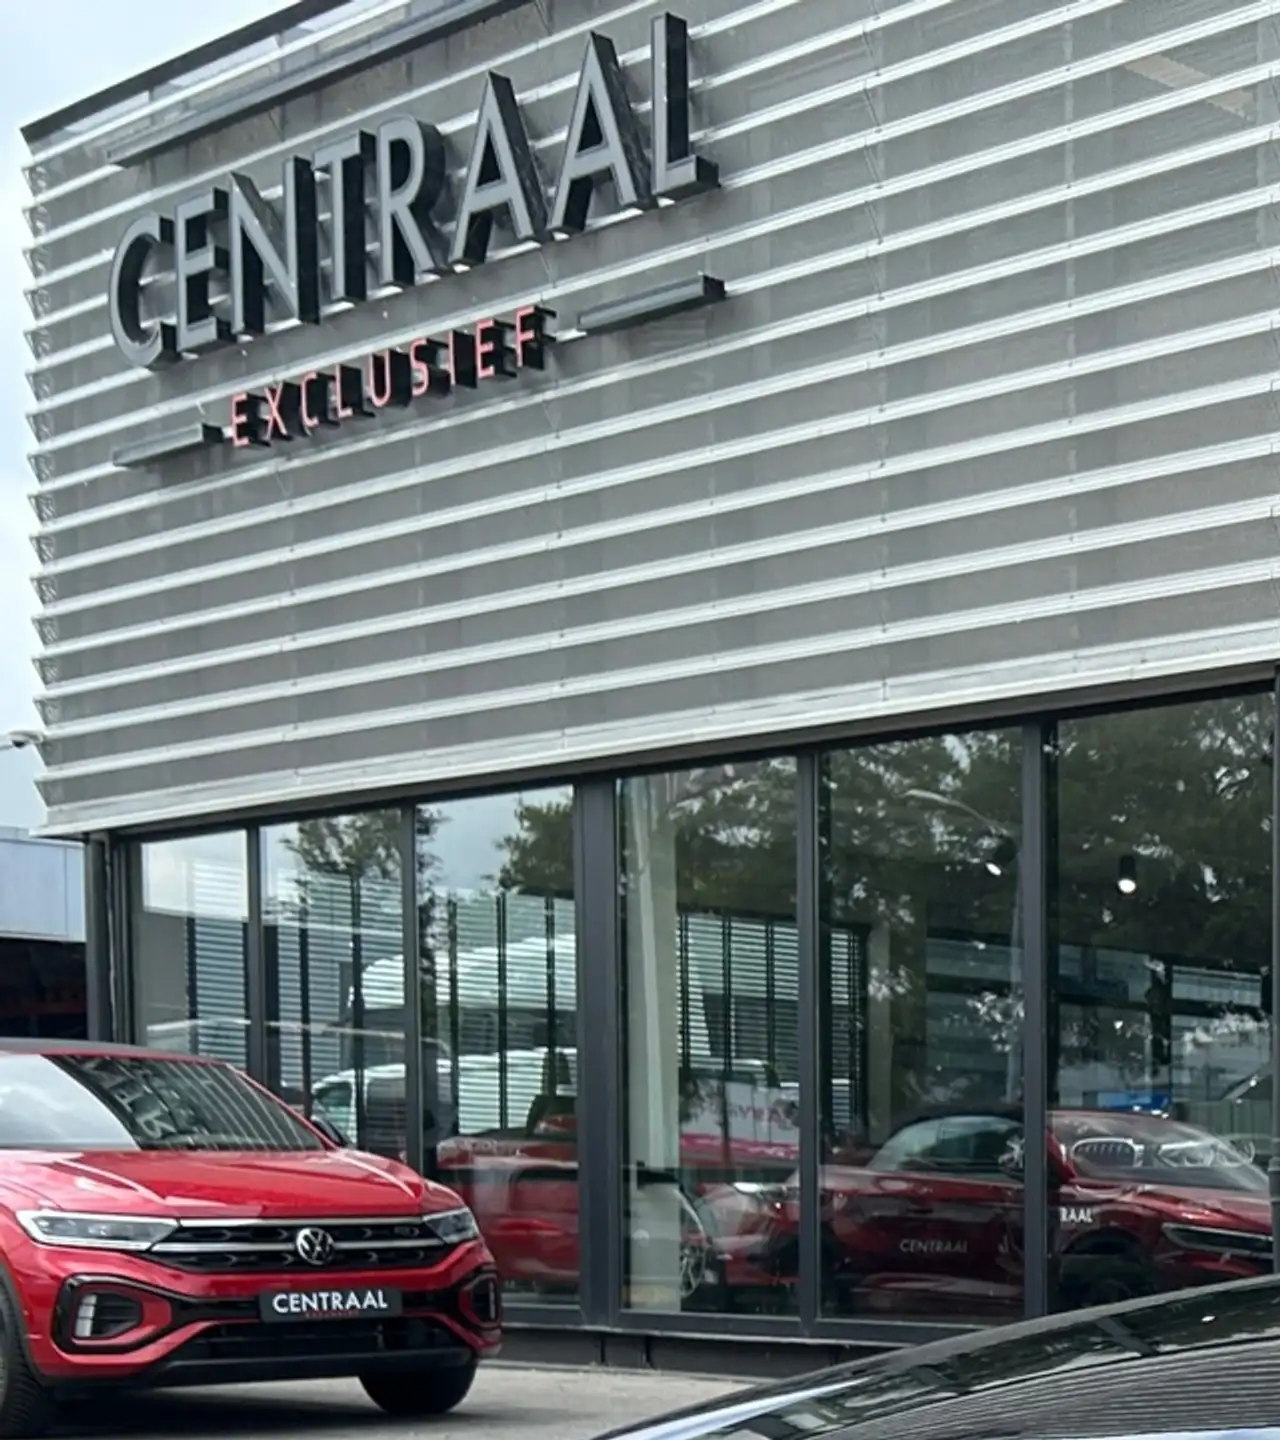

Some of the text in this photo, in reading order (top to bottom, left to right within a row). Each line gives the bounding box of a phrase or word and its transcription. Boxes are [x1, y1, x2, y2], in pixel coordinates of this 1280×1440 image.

[109, 11, 720, 369] CENTRAAL
[230, 305, 552, 448] EXCLUSIEF
[272, 1289, 388, 1314] CENTRAAL
